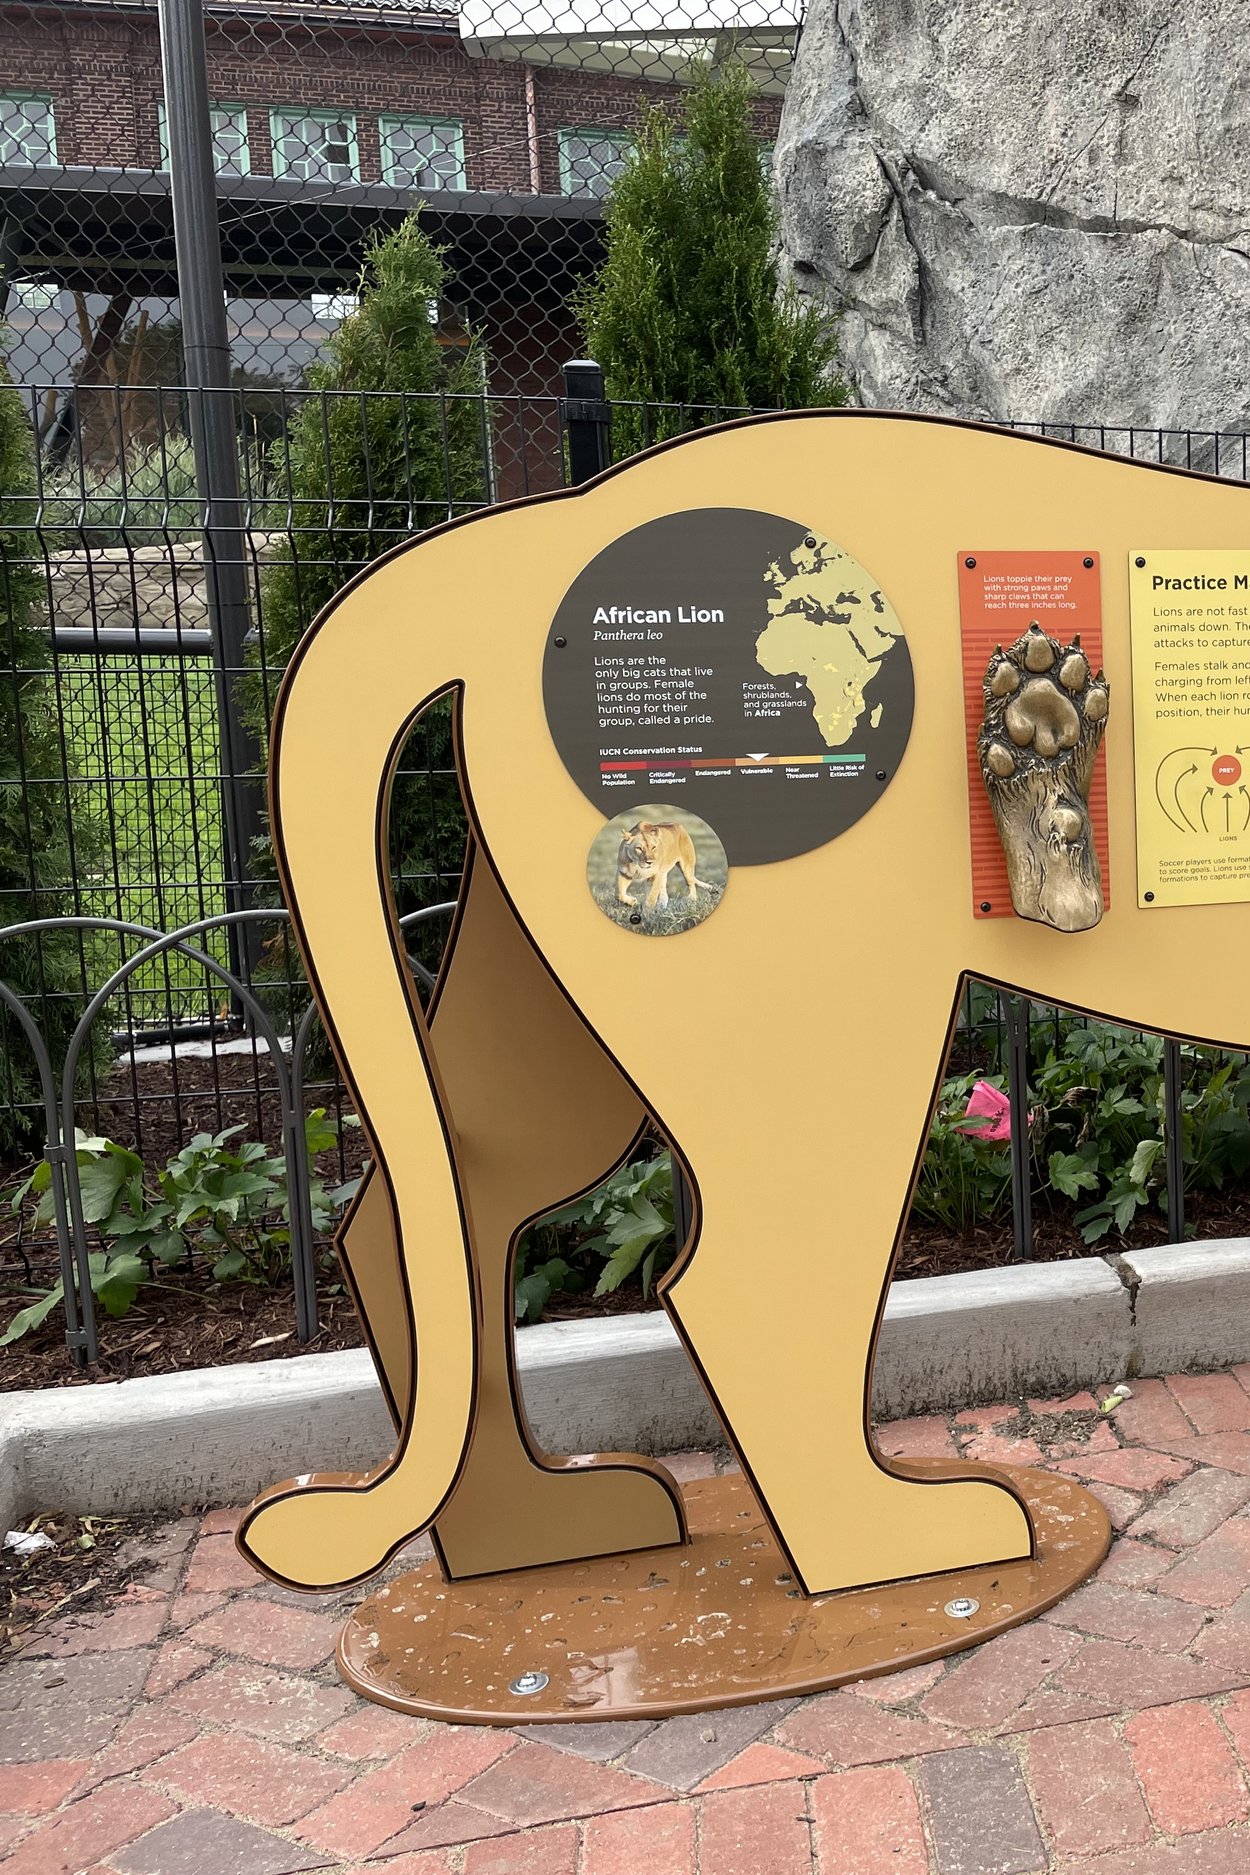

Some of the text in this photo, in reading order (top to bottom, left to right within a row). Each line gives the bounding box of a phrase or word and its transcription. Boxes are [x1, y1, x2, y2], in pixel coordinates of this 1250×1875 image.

[1007, 575, 1033, 584] topple
[1153, 575, 1227, 590] Practice
[1003, 584, 1029, 592] strong
[1058, 601, 1077, 610] long.
[593, 605, 724, 624] African Lion
[1154, 606, 1183, 617] Lions
[1186, 608, 1203, 616] are
[1207, 606, 1225, 616] not
[1228, 606, 1248, 616] fast
[1154, 622, 1195, 632] animals
[1199, 621, 1231, 632] down.
[593, 629, 663, 641] Panthera leo
[595, 656, 624, 666] Lions
[648, 655, 666, 665] the
[1155, 660, 1200, 671] Females
[1204, 660, 1228, 670] stalk
[595, 667, 713, 680] only big cats that live
[597, 679, 694, 692] in groups. Female
[743, 682, 776, 691] Forests,
[743, 691, 792, 700] shrublands,
[1155, 691, 1187, 702] When
[1191, 690, 1216, 701] each
[1220, 690, 1239, 700] lion
[744, 700, 807, 709] and grasslands
[745, 709, 781, 717] in Africa
[599, 718, 635, 728] group,
[638, 715, 670, 725] called
[684, 714, 714, 726] pride.
[600, 745, 702, 756] IUCN Conservation Status
[1186, 857, 1212, 866] players
